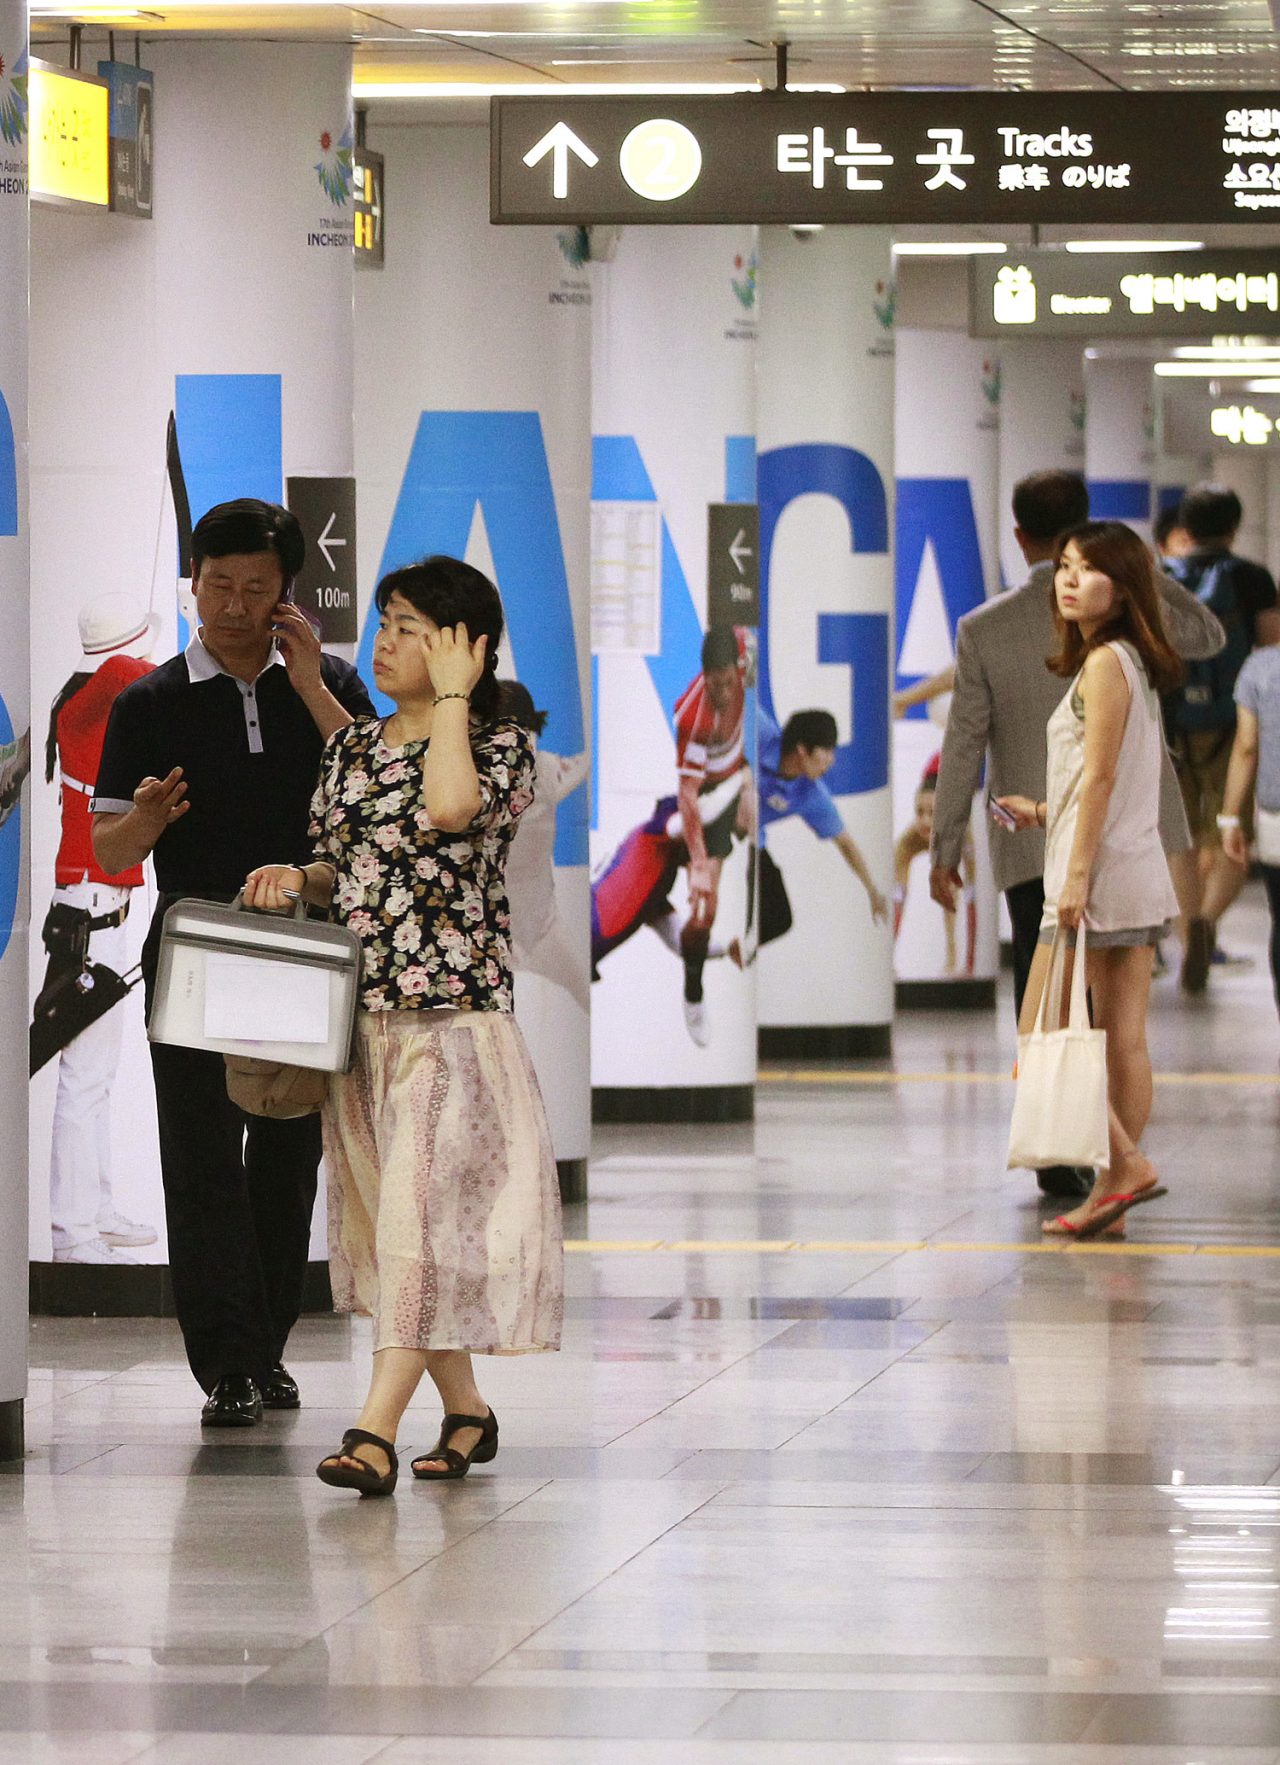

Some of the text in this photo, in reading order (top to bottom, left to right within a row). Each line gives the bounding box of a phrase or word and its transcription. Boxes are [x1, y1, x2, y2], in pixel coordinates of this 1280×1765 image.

[644, 135, 679, 185] 2
[775, 126, 976, 192] 타는 곳
[996, 126, 1094, 158] Tracks
[1062, 163, 1131, 189] のりば
[1119, 272, 1278, 314] 엘리베이터
[315, 586, 350, 608] 100m
[756, 442, 889, 796] G
